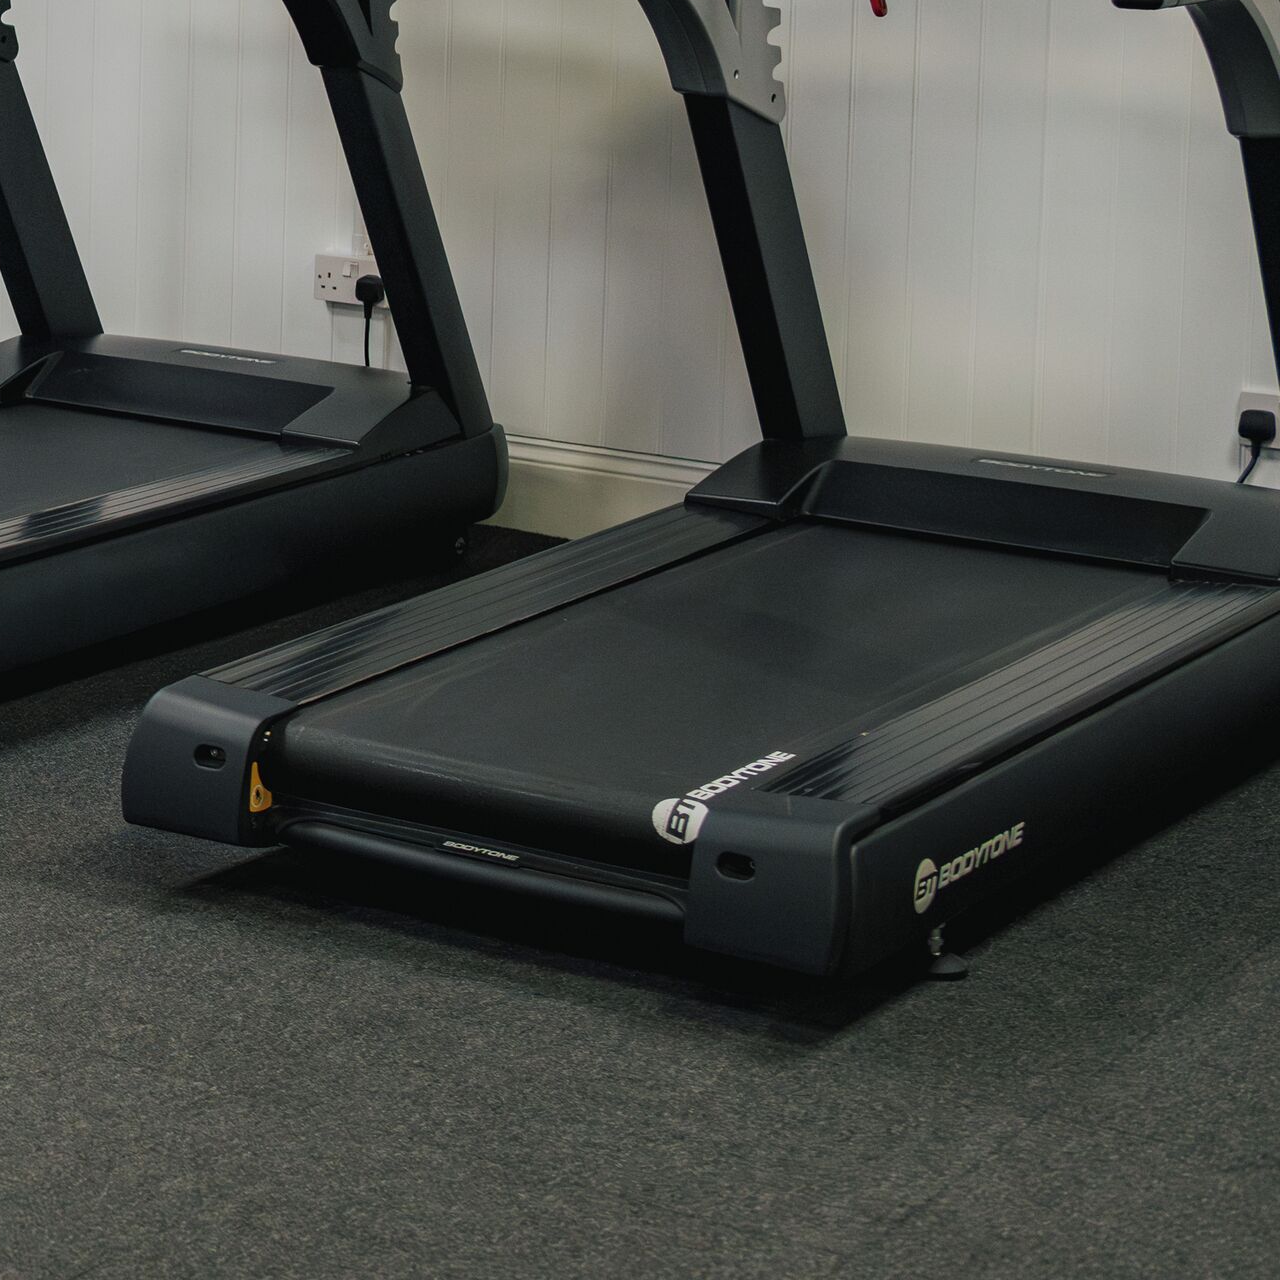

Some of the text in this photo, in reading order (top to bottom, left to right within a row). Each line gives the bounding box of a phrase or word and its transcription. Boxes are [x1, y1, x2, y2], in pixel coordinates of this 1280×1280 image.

[686, 750, 797, 802] BODYTONE
[442, 840, 519, 861] BODYTONE
[938, 821, 1026, 890] BODYTONE
